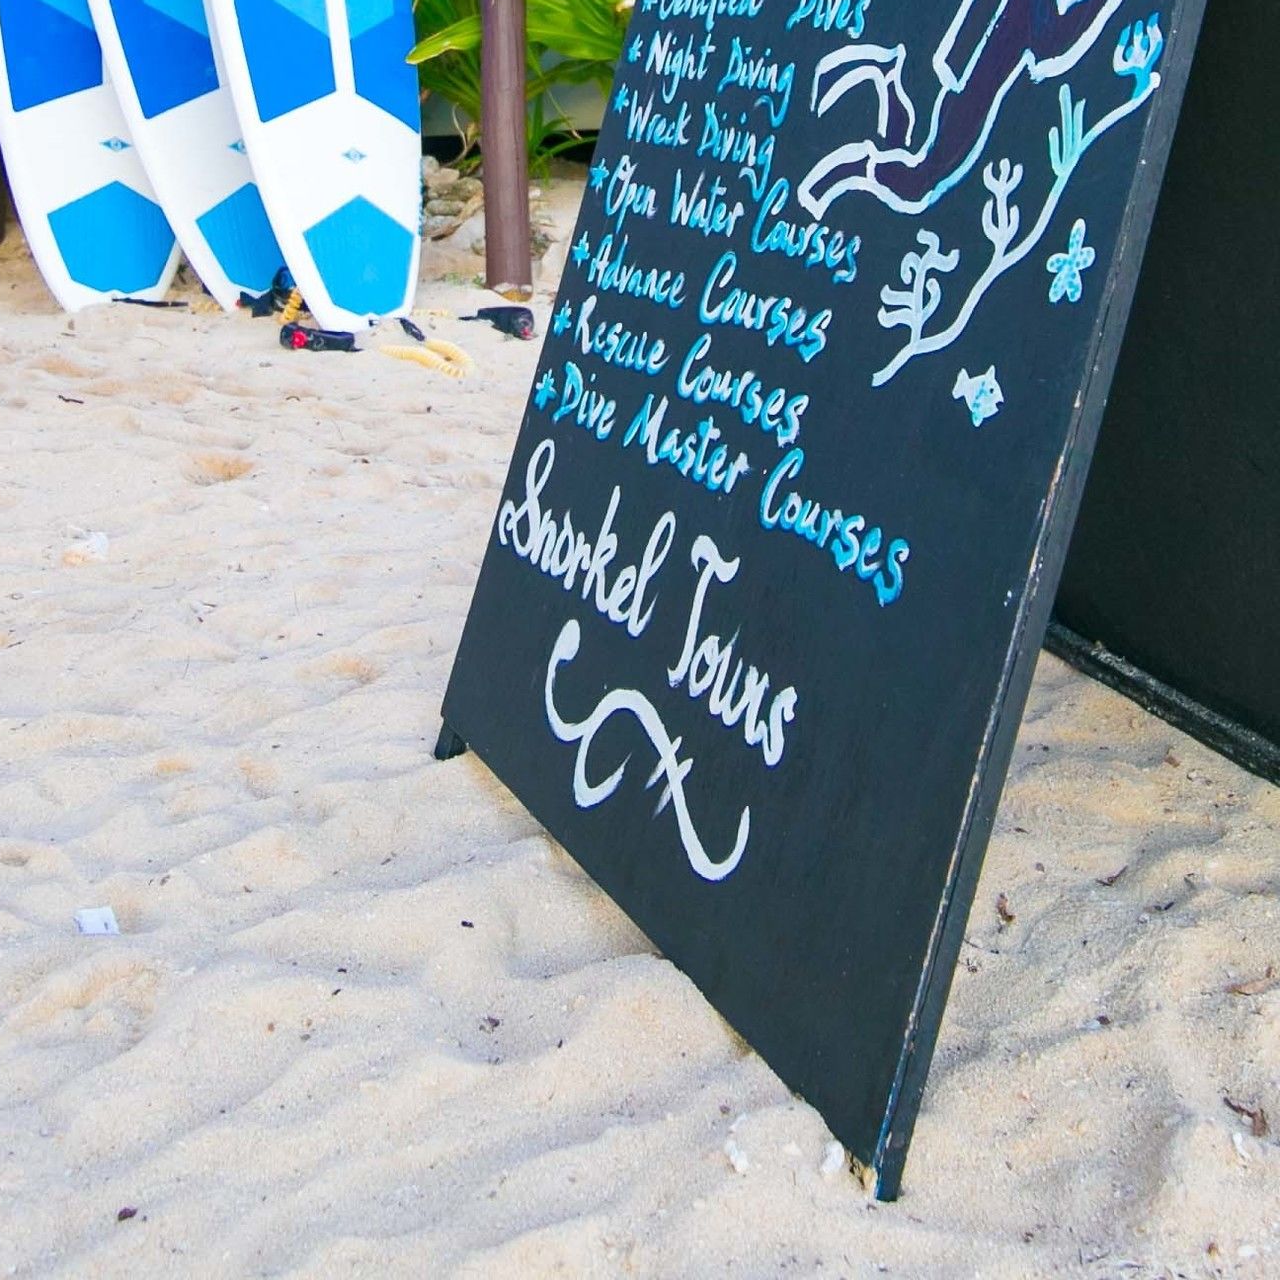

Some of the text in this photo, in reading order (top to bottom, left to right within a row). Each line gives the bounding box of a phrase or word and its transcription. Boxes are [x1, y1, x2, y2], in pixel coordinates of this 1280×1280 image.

[626, 89, 775, 200] Wreck Diving
[645, 29, 796, 128] Night Diving
[605, 154, 862, 284] Open Water Courses
[586, 231, 833, 363] Advance Courses
[573, 294, 809, 448] Rescue Courses
[555, 361, 910, 607] Dive Master Courses
[498, 438, 798, 767] Snorkel Tours
